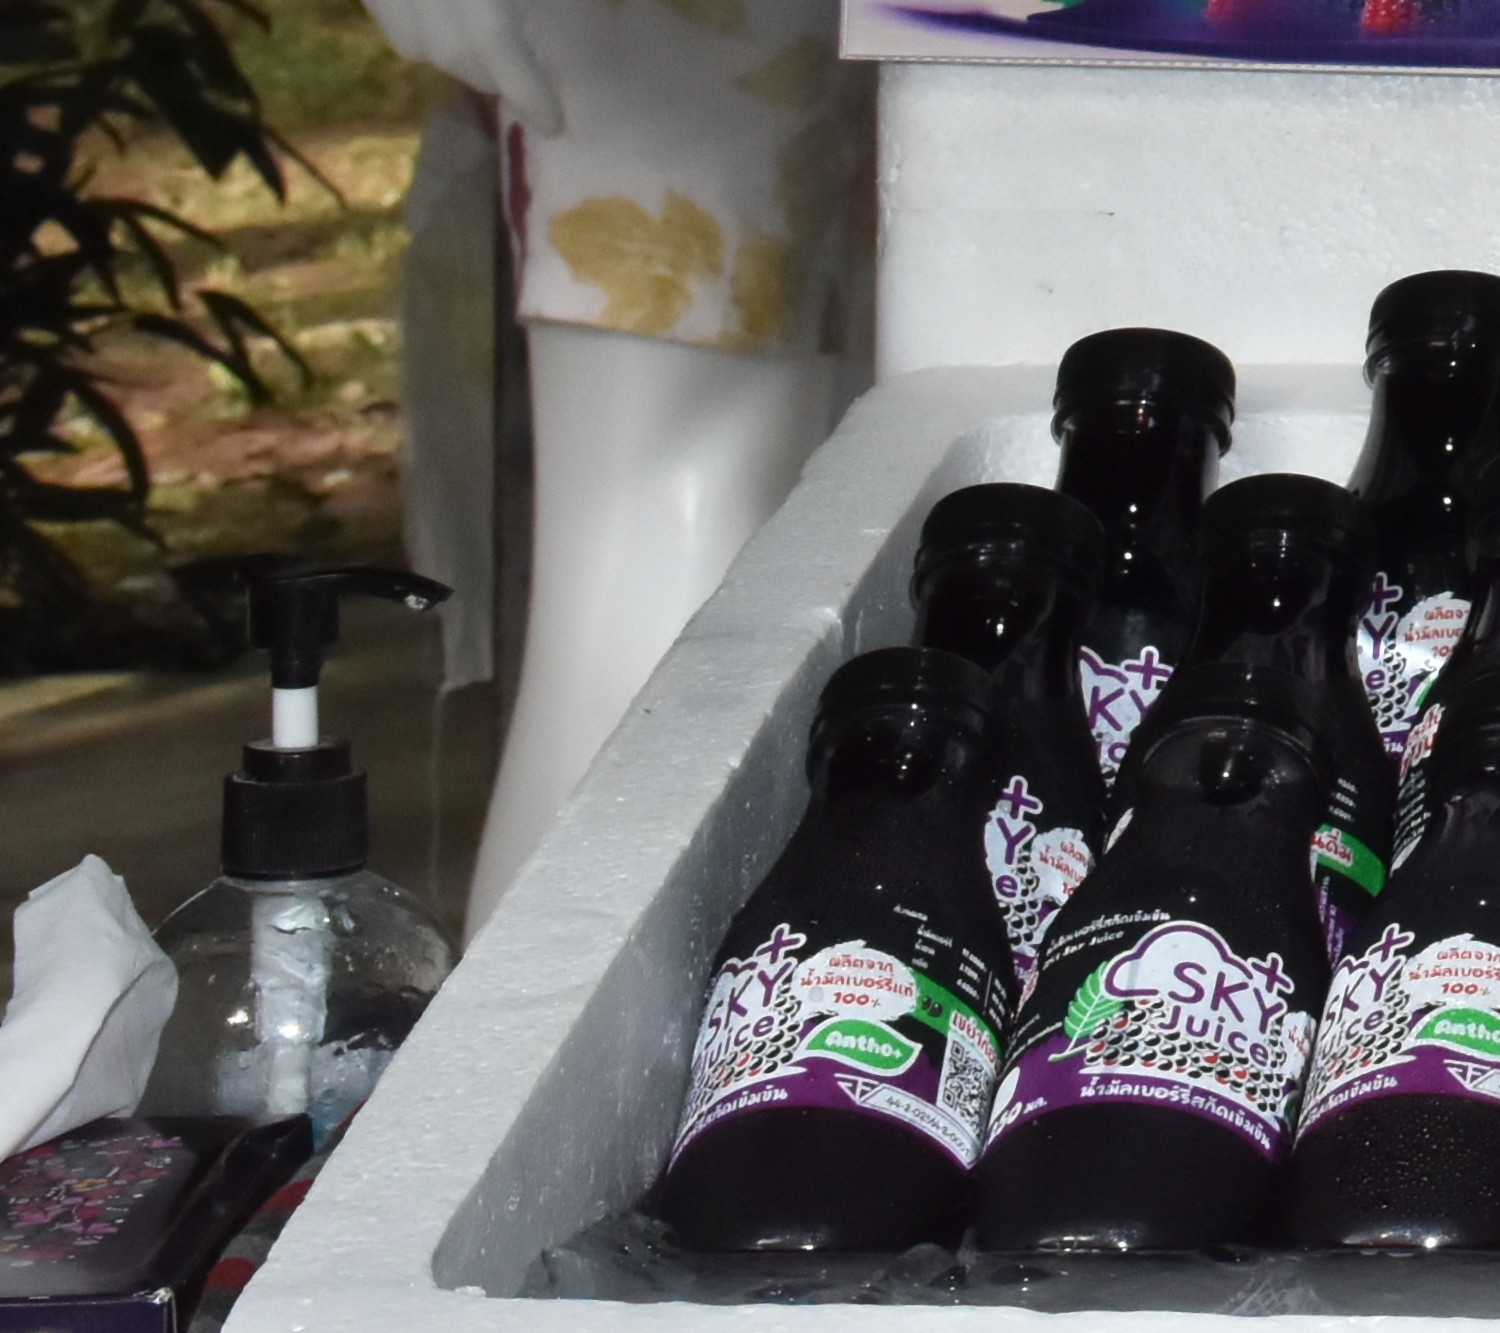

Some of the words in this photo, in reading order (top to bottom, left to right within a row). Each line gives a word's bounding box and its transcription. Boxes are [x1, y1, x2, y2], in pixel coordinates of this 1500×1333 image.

[828, 952, 894, 973] ผลิตจาก
[1158, 1005, 1269, 1067] Juice
